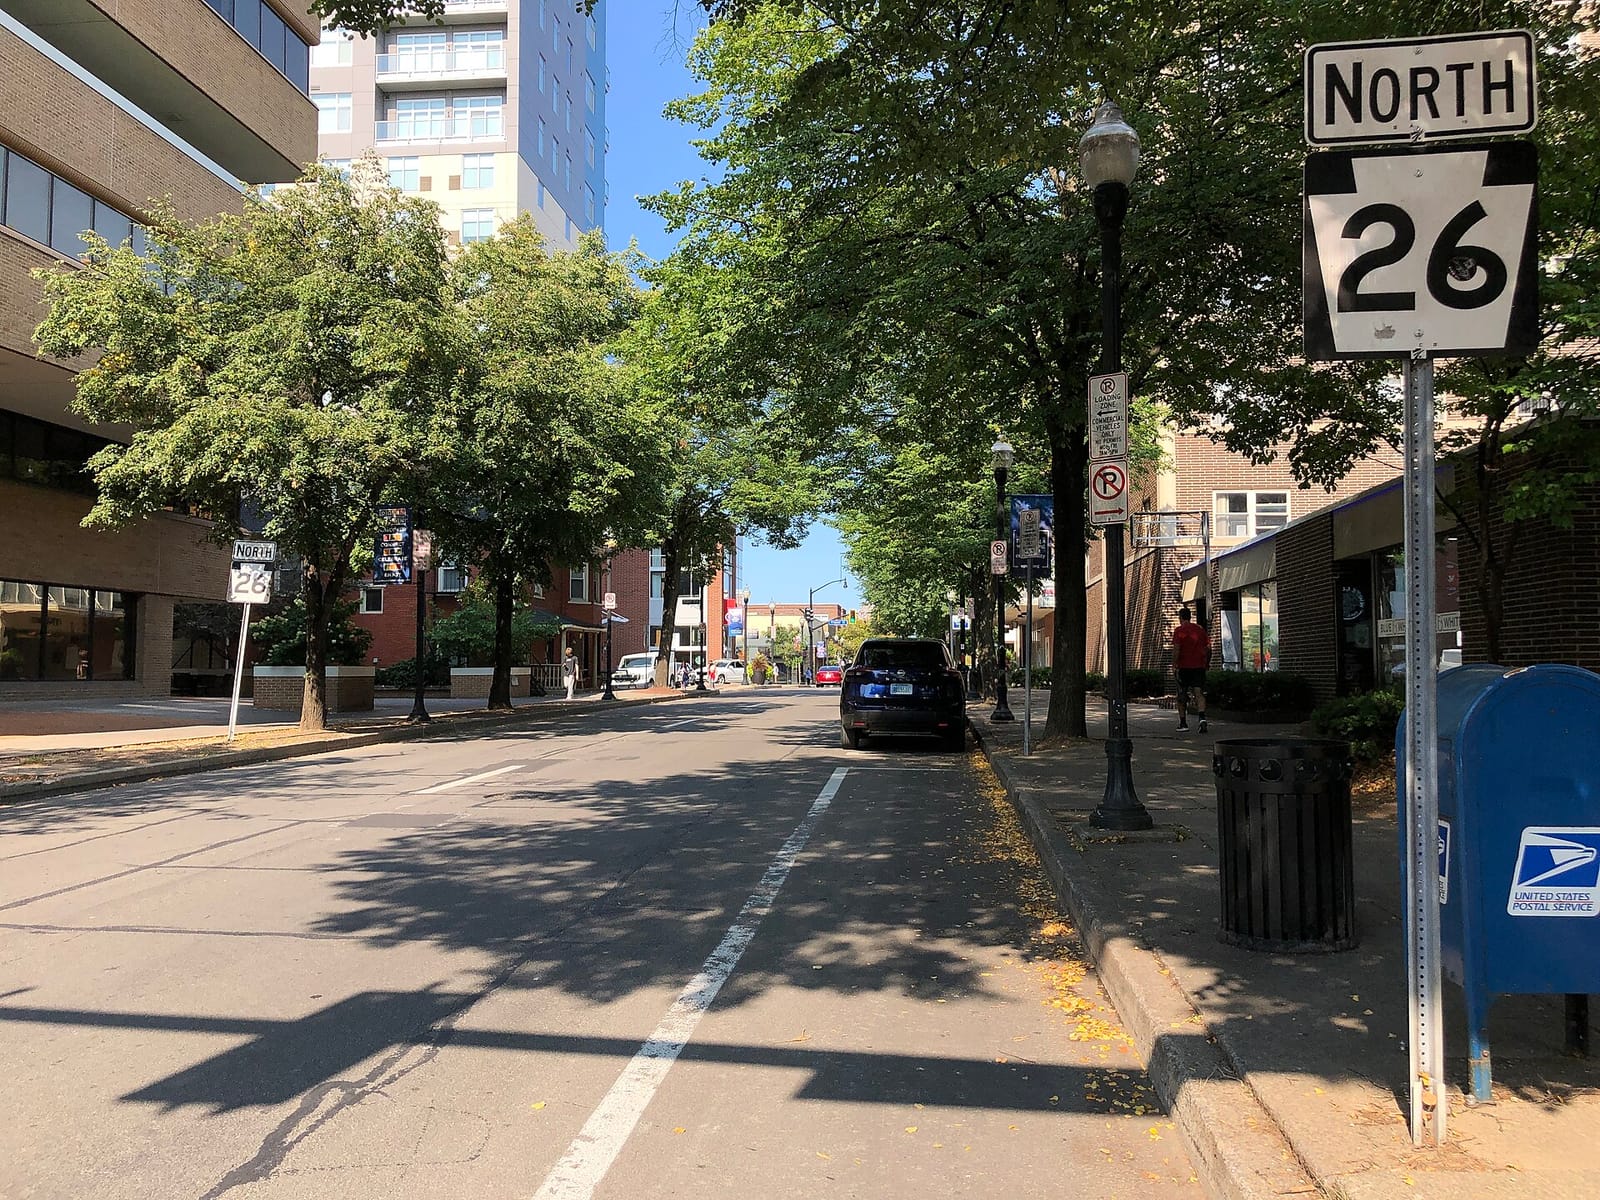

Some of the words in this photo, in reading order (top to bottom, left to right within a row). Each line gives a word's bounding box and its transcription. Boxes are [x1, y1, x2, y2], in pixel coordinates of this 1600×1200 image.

[1325, 60, 1514, 125] NORTH
[1337, 200, 1507, 313] 26
[1095, 393, 1121, 403] LOADING
[1100, 401, 1116, 409] ZONE
[1092, 415, 1124, 425] COMMERCIAL
[1096, 423, 1121, 431] VEHICLES
[236, 544, 272, 558] NORTH
[234, 572, 266, 594] 26
[1514, 892, 1554, 900] UNITED
[1555, 892, 1590, 901] STATES
[1512, 902, 1550, 911] POSTAL
[1552, 903, 1593, 911] SERVICE
